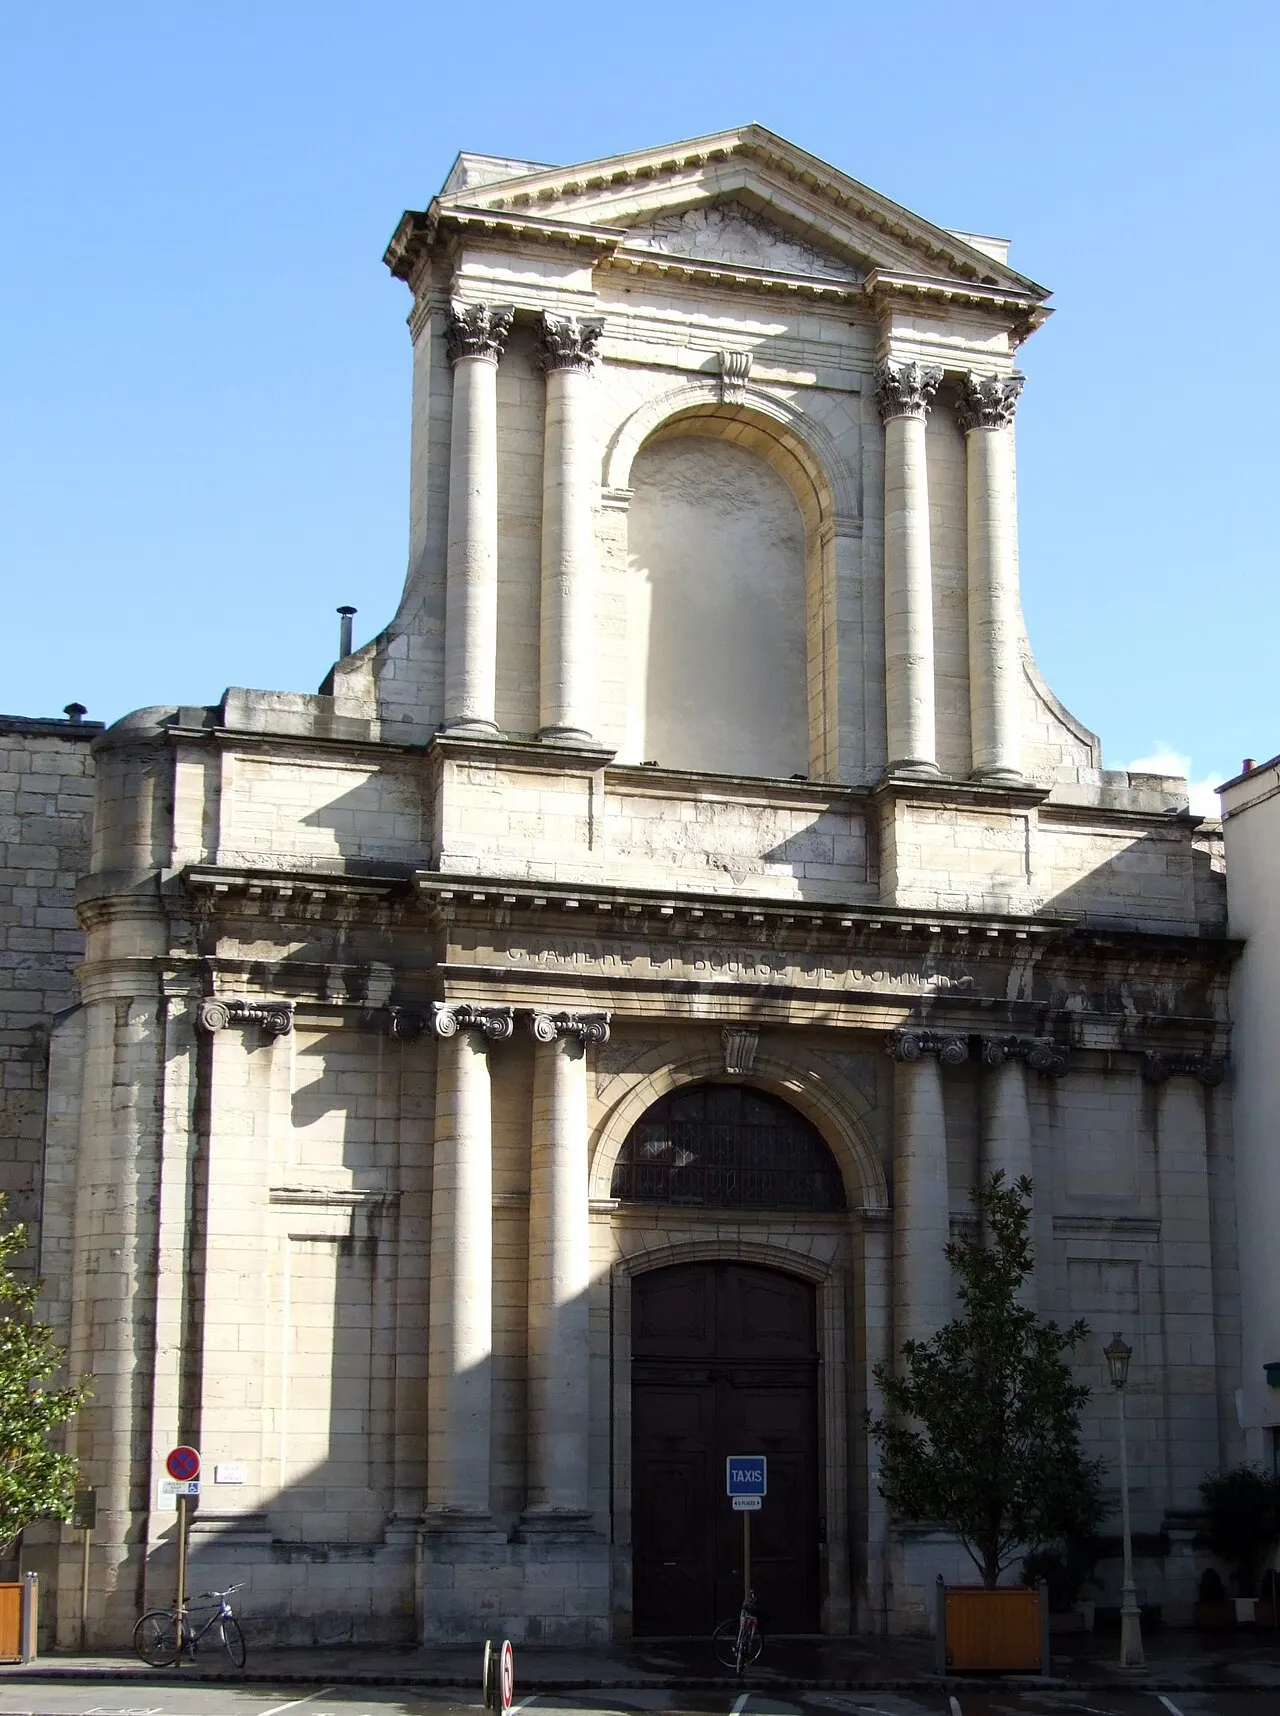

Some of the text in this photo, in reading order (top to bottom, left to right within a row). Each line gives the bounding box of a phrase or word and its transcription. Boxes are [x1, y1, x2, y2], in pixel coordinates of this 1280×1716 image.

[507, 938, 983, 990] CHAMBRE ET BOURSE DE COMMERCE
[732, 1469, 762, 1482] TAXIS
